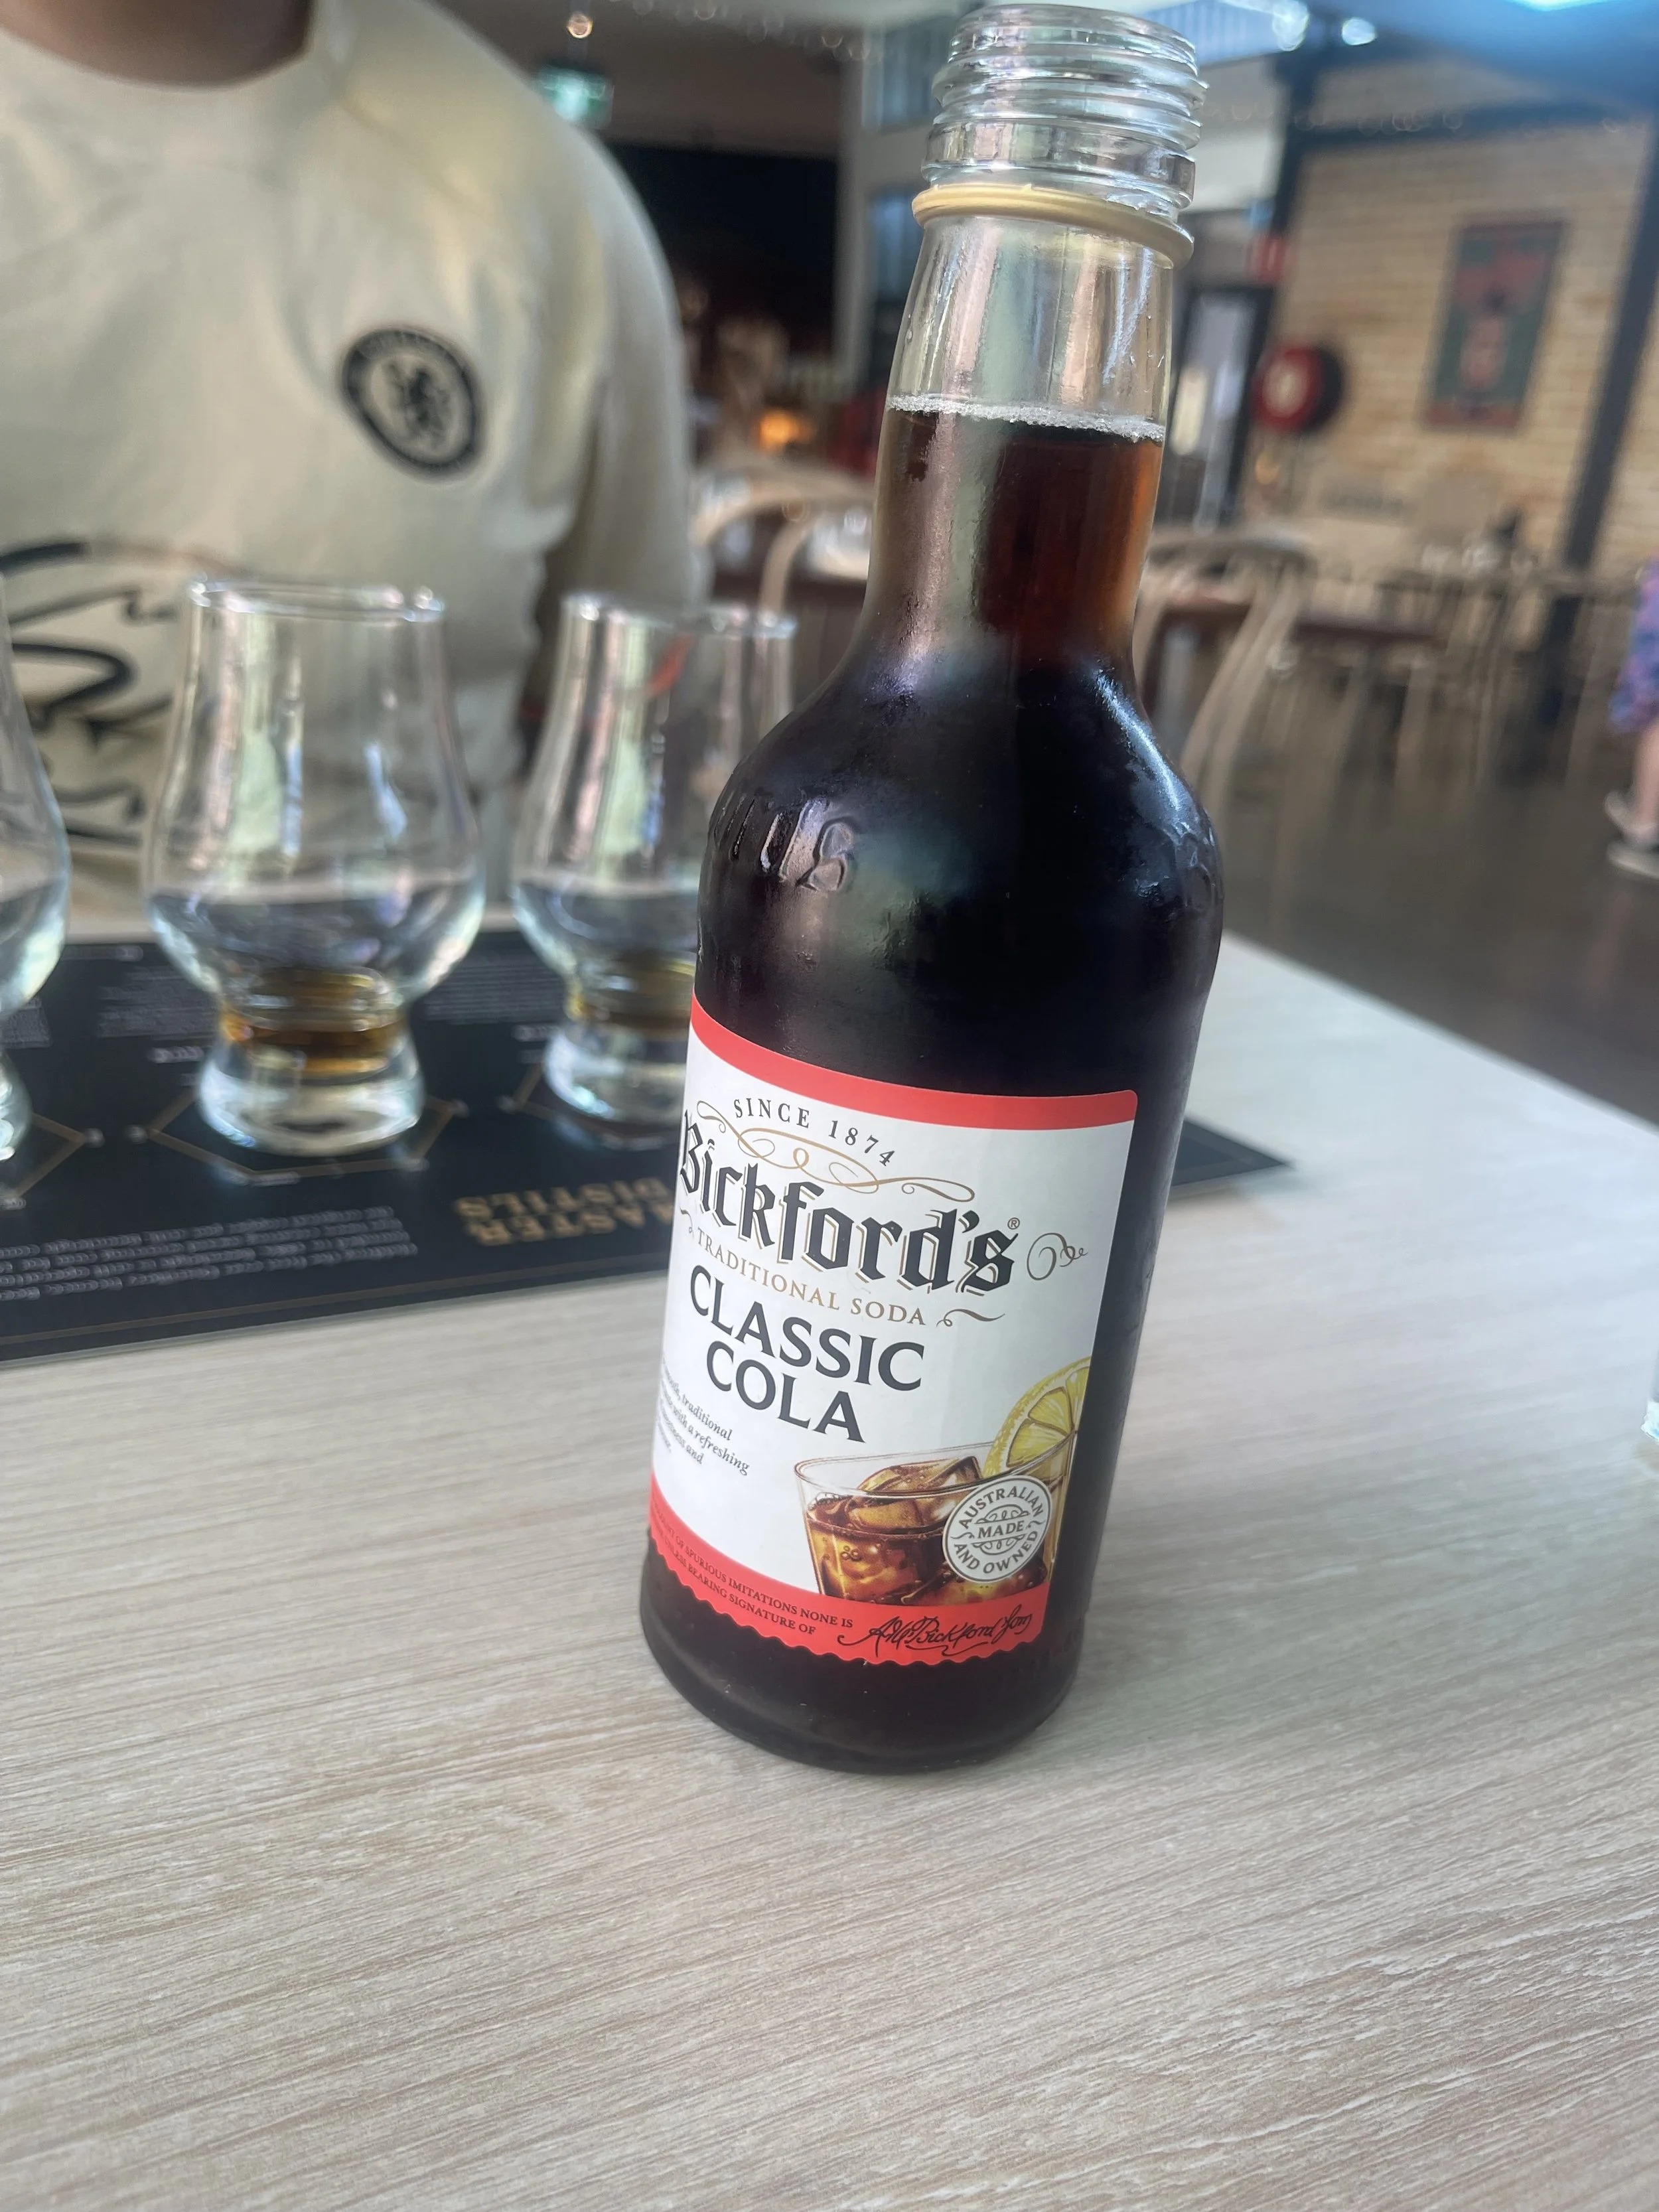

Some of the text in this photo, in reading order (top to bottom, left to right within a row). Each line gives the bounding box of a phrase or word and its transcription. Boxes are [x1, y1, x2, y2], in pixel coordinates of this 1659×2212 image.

[733, 1098, 895, 1167] SINCE 1874
[680, 1109, 1019, 1297] Bickford's
[697, 1227, 926, 1326] TRADITIONAL SODA
[690, 1264, 925, 1391] CLASSIC
[682, 1394, 733, 1441] traditional
[707, 1341, 866, 1443] COLA
[673, 1405, 688, 1429] with
[688, 1424, 693, 1434] a
[694, 1430, 751, 1477] refreshing
[685, 1444, 705, 1465] and
[958, 1485, 1044, 1530] AUSTRALIAN
[977, 1520, 1025, 1539] MADE
[685, 1546, 727, 1583] SPURIOUS
[729, 1576, 798, 1615] IMITATIONS
[800, 1607, 838, 1625] NONE
[841, 1617, 853, 1628] IS
[954, 1530, 1039, 1574] AND OWNED
[688, 1563, 727, 1598] BEARING
[729, 1593, 796, 1630] SIGNATURE
[798, 1623, 816, 1635] OF
